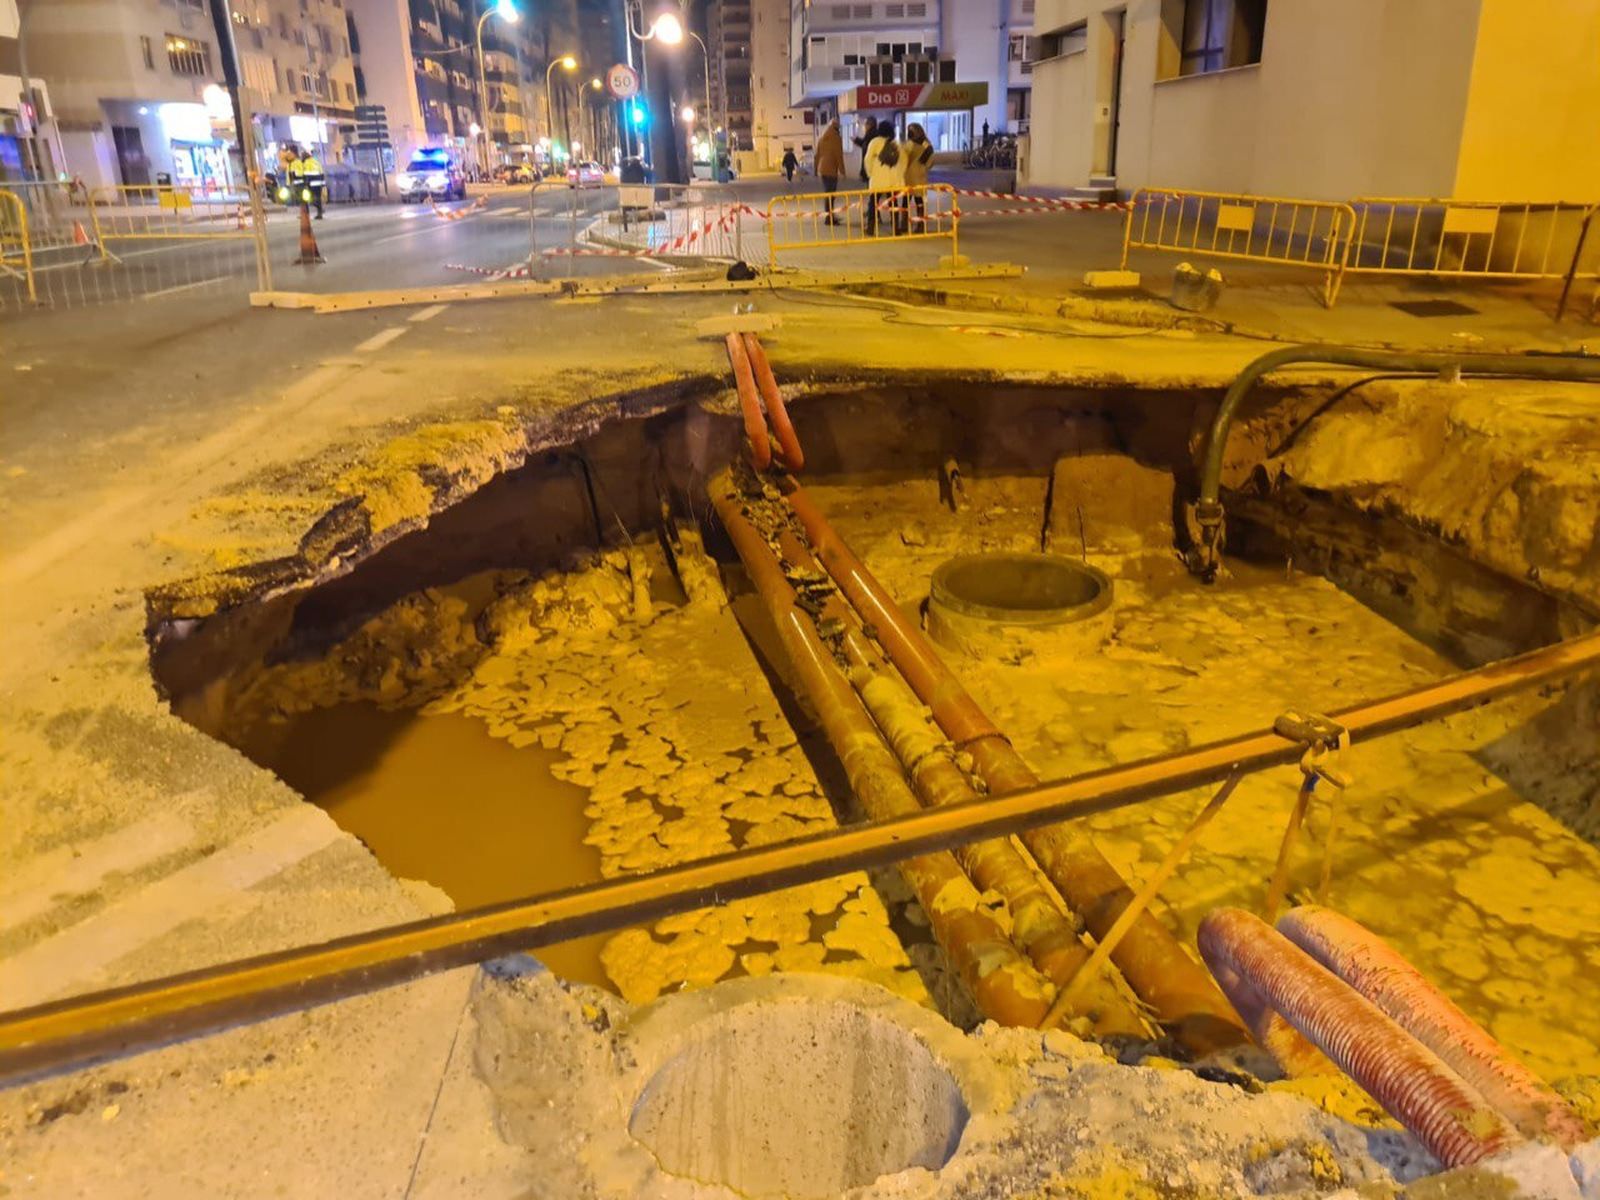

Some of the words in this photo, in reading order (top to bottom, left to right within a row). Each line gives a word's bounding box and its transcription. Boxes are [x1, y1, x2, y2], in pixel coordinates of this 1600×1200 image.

[614, 75, 631, 88] 50
[868, 92, 892, 104] Dia
[941, 90, 969, 101] MAXI
